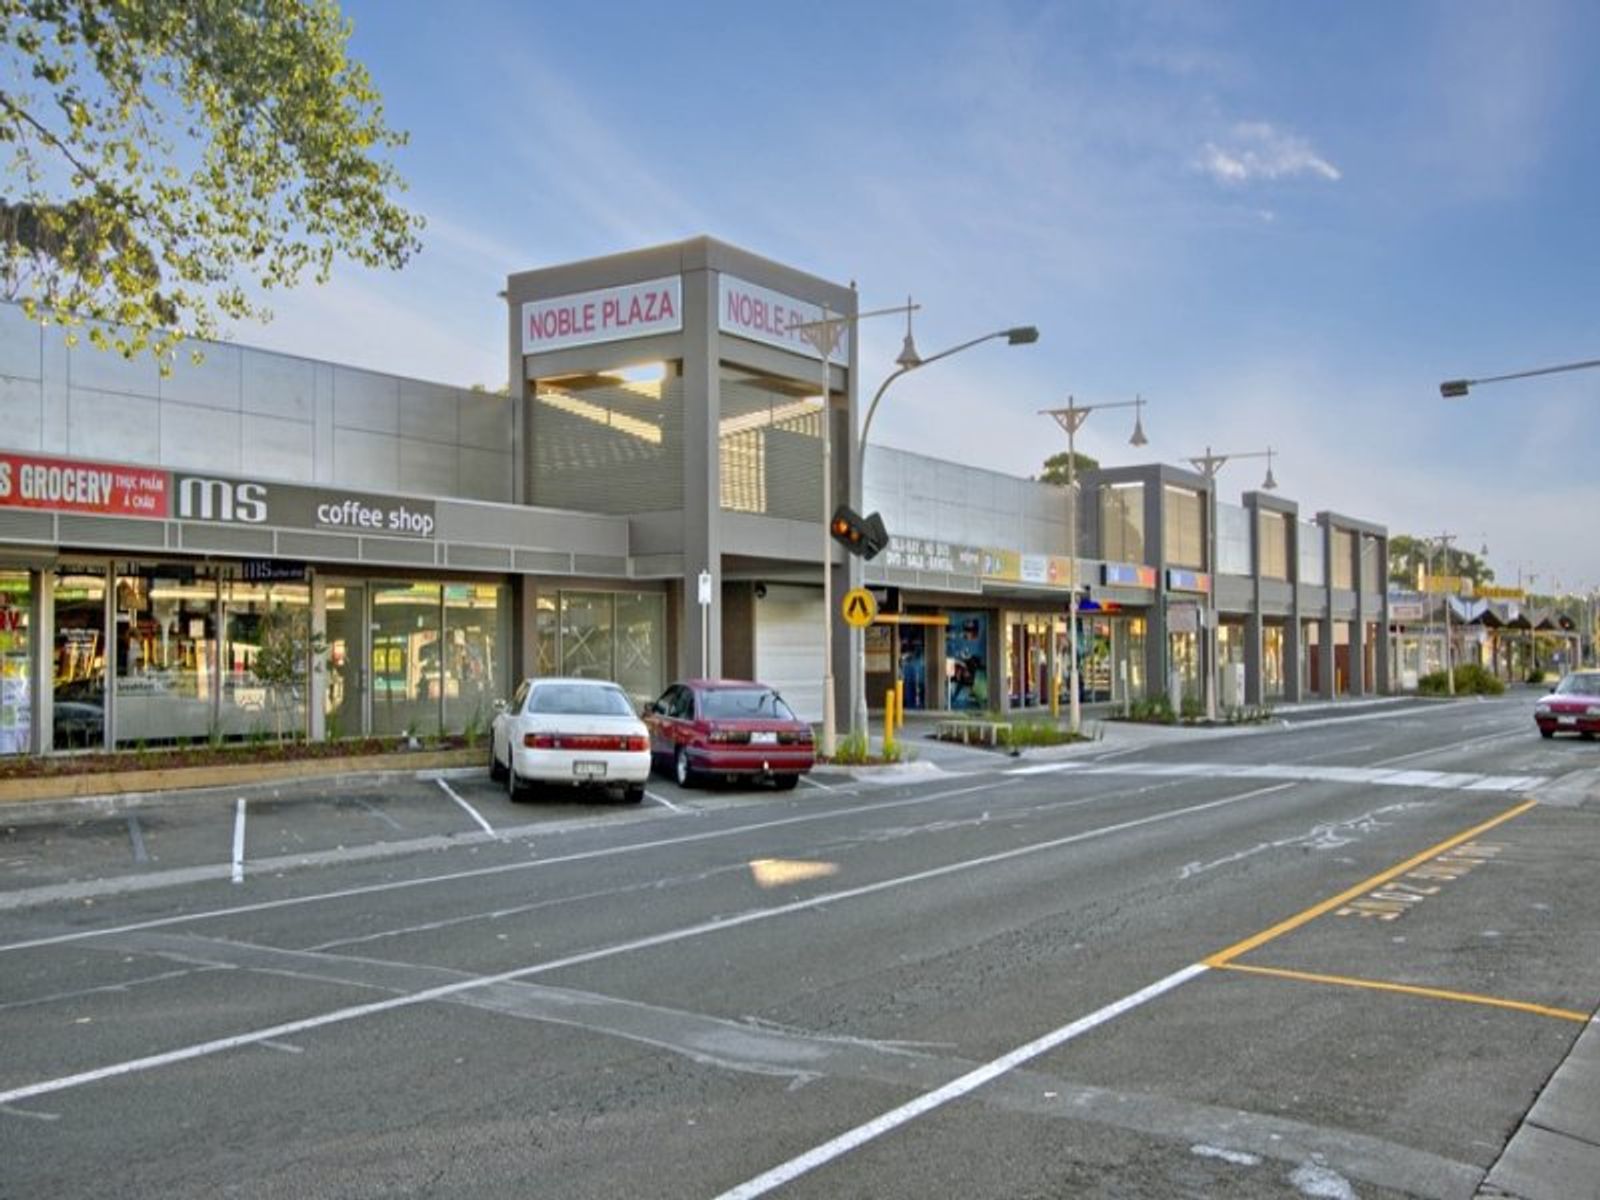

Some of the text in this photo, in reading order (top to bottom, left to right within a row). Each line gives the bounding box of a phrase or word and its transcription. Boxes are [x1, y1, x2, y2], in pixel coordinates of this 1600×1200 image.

[529, 290, 675, 341] NOBLE PLAZA
[728, 288, 785, 336] NOBLE
[20, 464, 113, 505] GROCERY
[180, 477, 267, 522] ms
[317, 500, 433, 537] coffee shop
